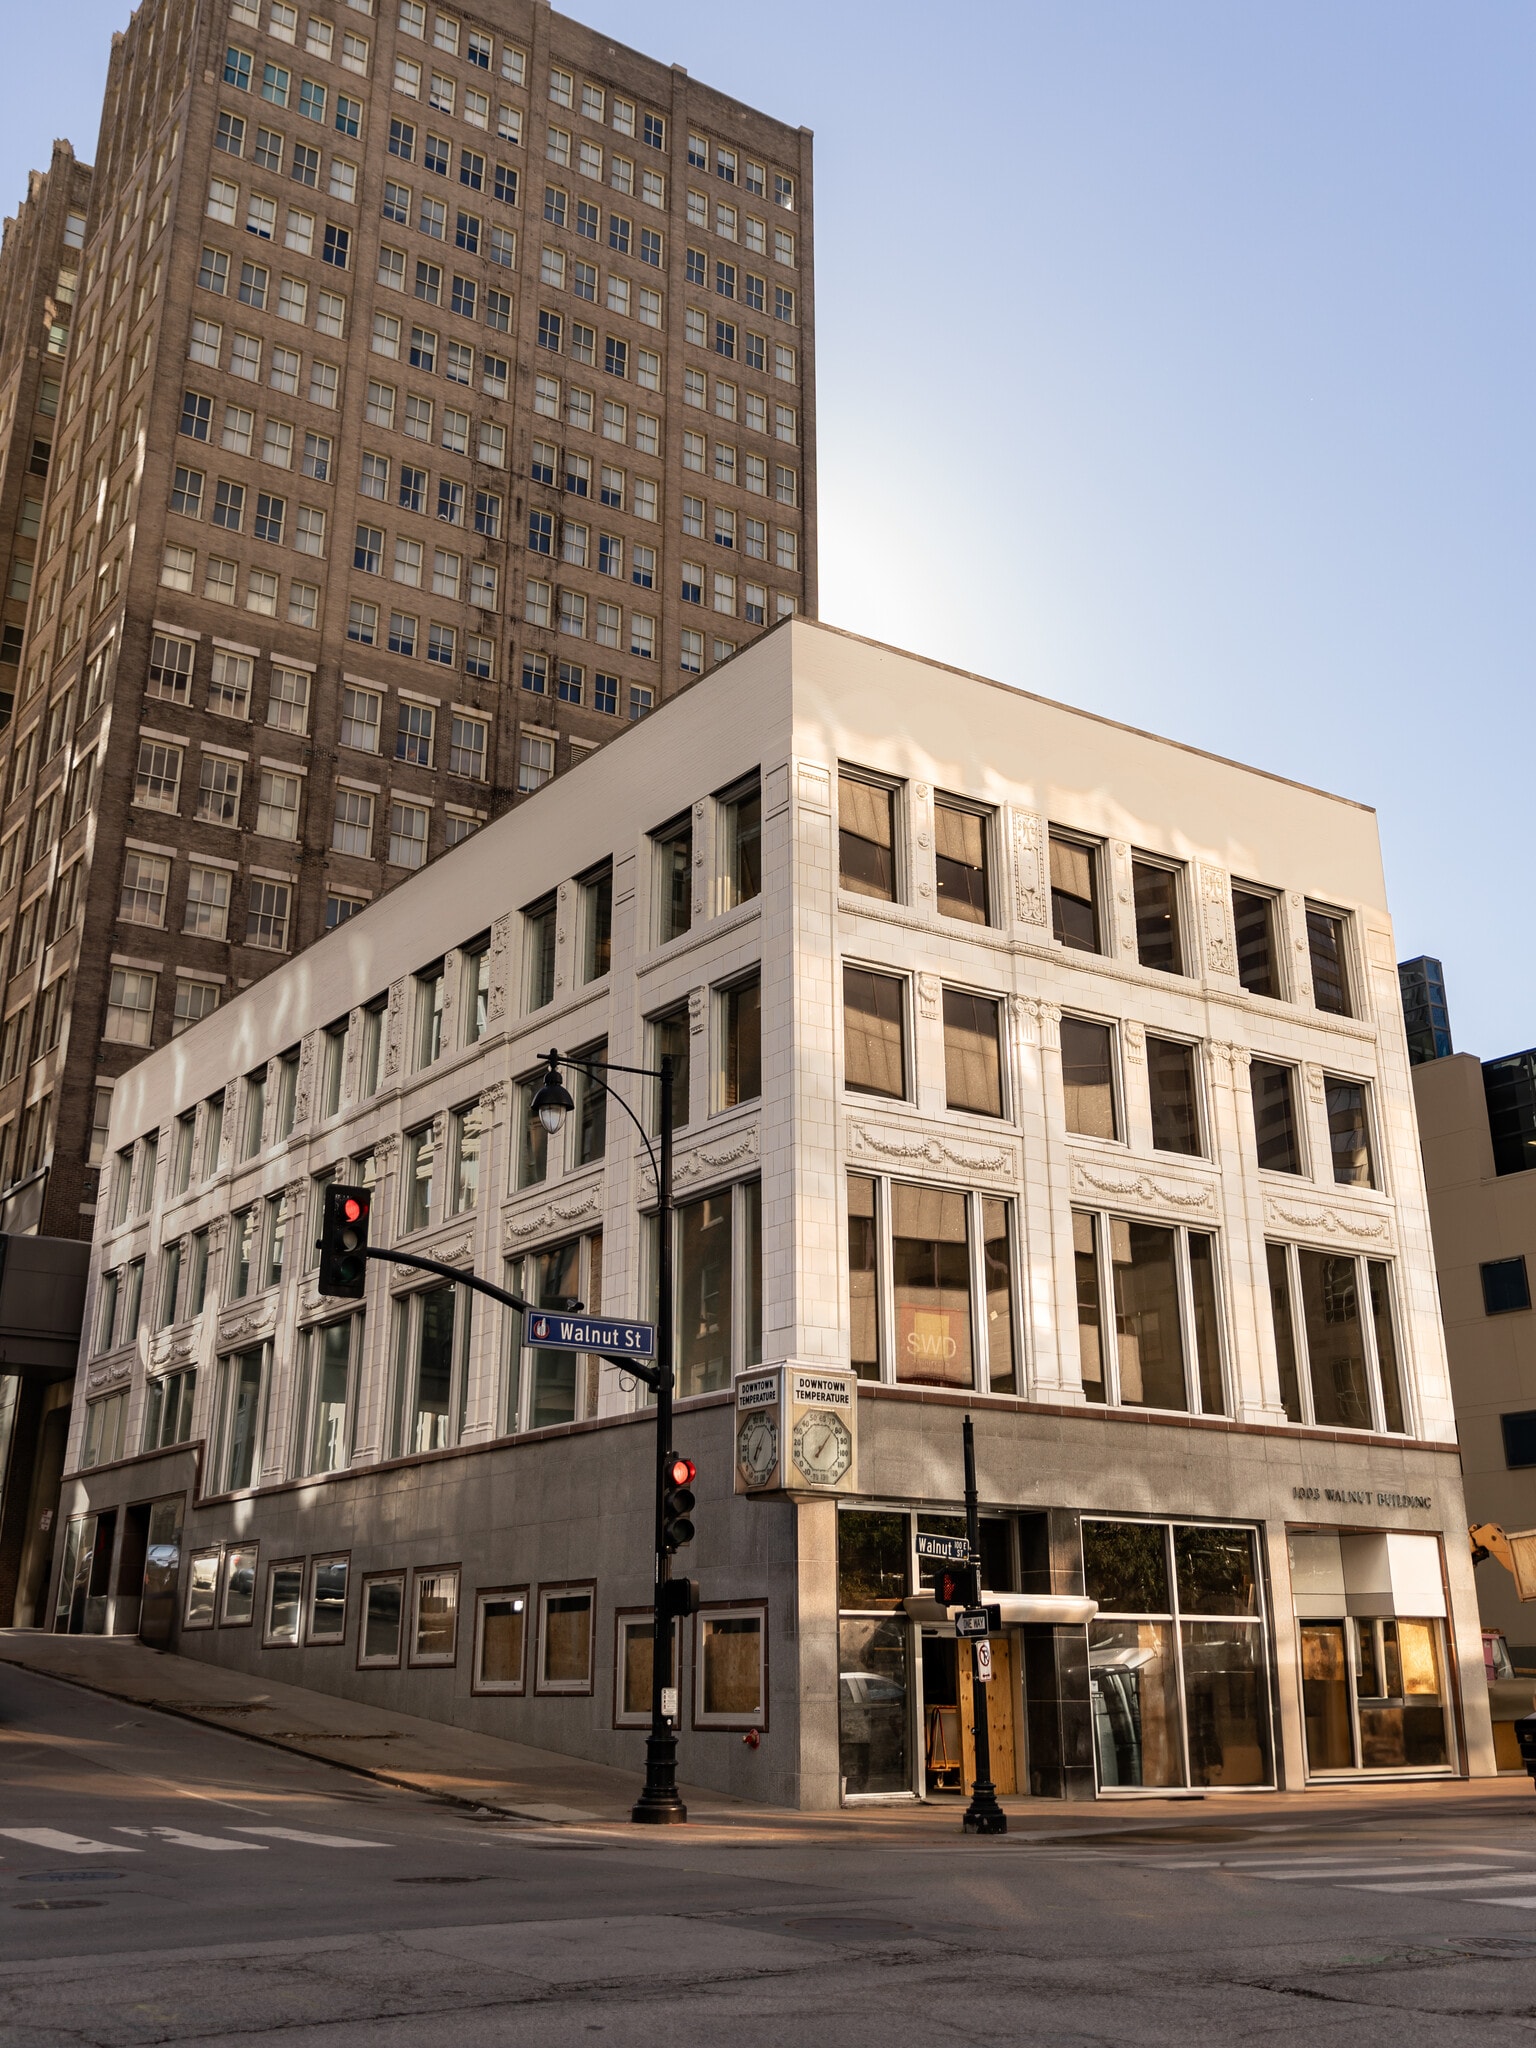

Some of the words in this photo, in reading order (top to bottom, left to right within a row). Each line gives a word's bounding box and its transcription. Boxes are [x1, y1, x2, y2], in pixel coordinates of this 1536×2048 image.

[560, 1322, 619, 1346] Walnut
[625, 1330, 641, 1348] St
[907, 1333, 956, 1359] SWD
[742, 1379, 773, 1394] DOWNTOWN
[799, 1378, 845, 1392] DOWNTOWN
[739, 1391, 776, 1405] TEMPERATURE
[796, 1390, 849, 1404] TEMPERATURE
[1324, 1488, 1372, 1504] WALNUT
[1377, 1492, 1431, 1509] BUILDING
[918, 1537, 952, 1556] Walnut
[954, 1541, 962, 1549] 100
[963, 1542, 967, 1550] E
[956, 1549, 963, 1557] ST
[963, 1618, 973, 1628] ONE
[973, 1617, 984, 1629] WAY
